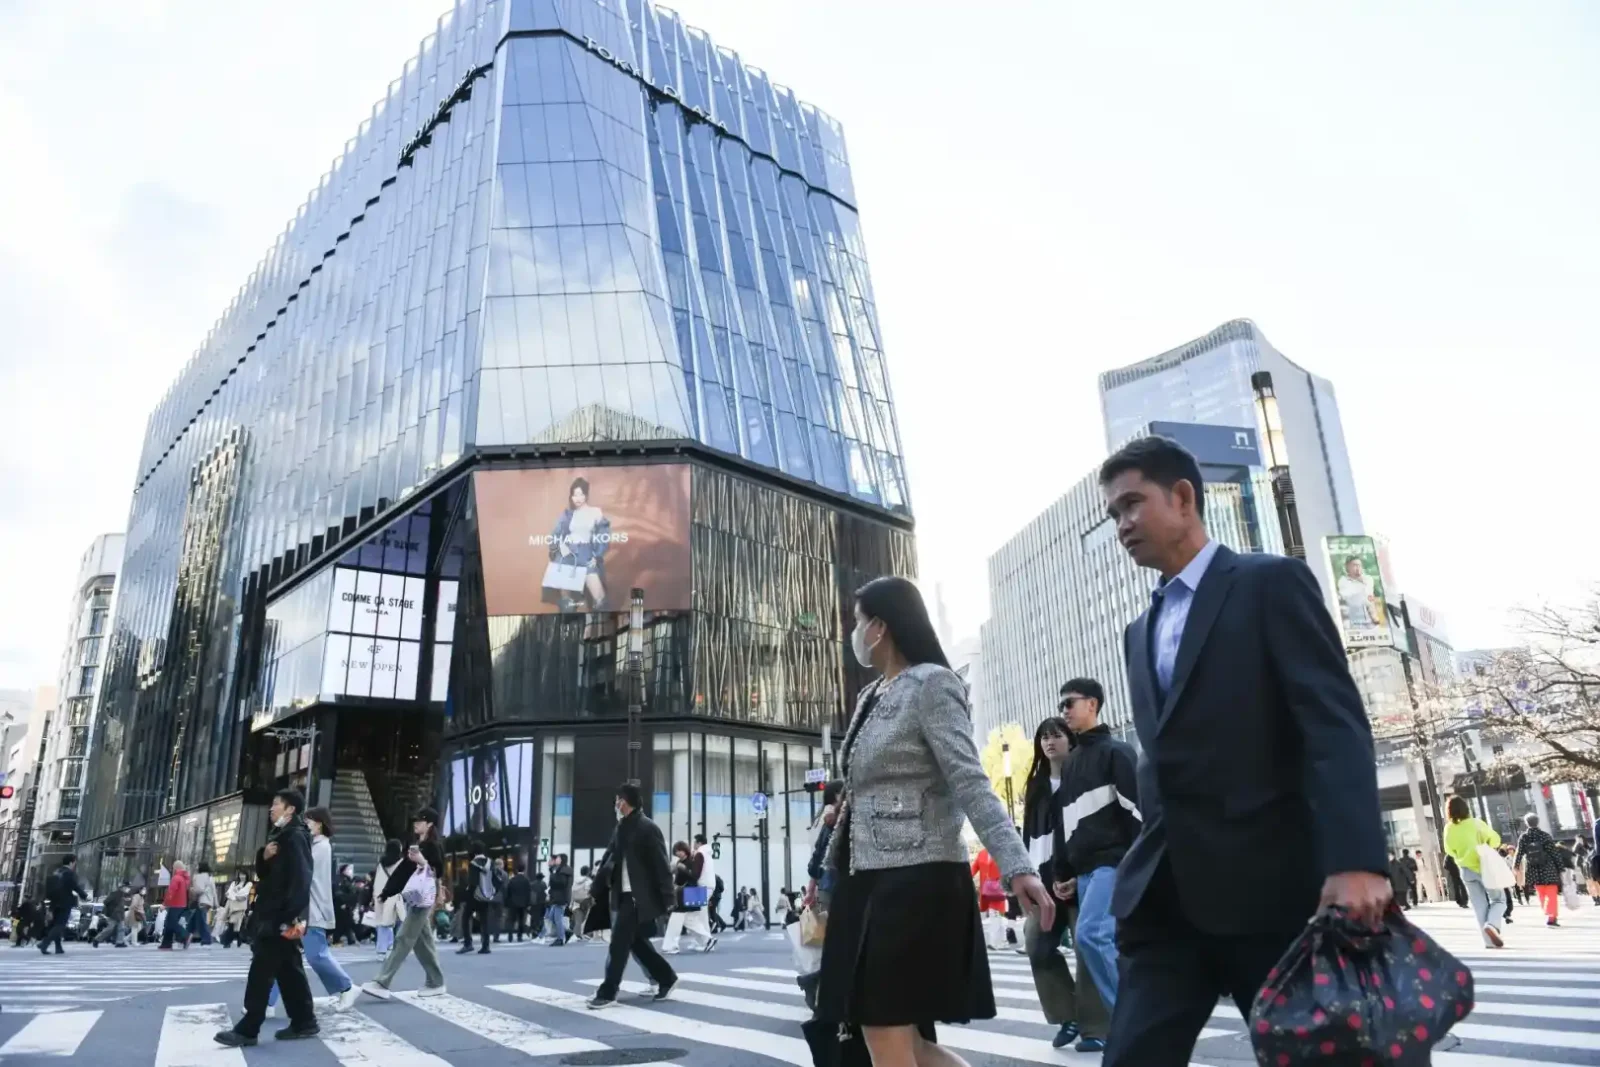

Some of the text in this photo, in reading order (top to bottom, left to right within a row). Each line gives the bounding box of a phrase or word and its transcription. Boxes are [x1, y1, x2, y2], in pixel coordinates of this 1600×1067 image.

[592, 532, 629, 544] KORS
[341, 592, 372, 605] COMME
[388, 597, 415, 610] STAGE
[341, 659, 403, 673] NEW OPEN
